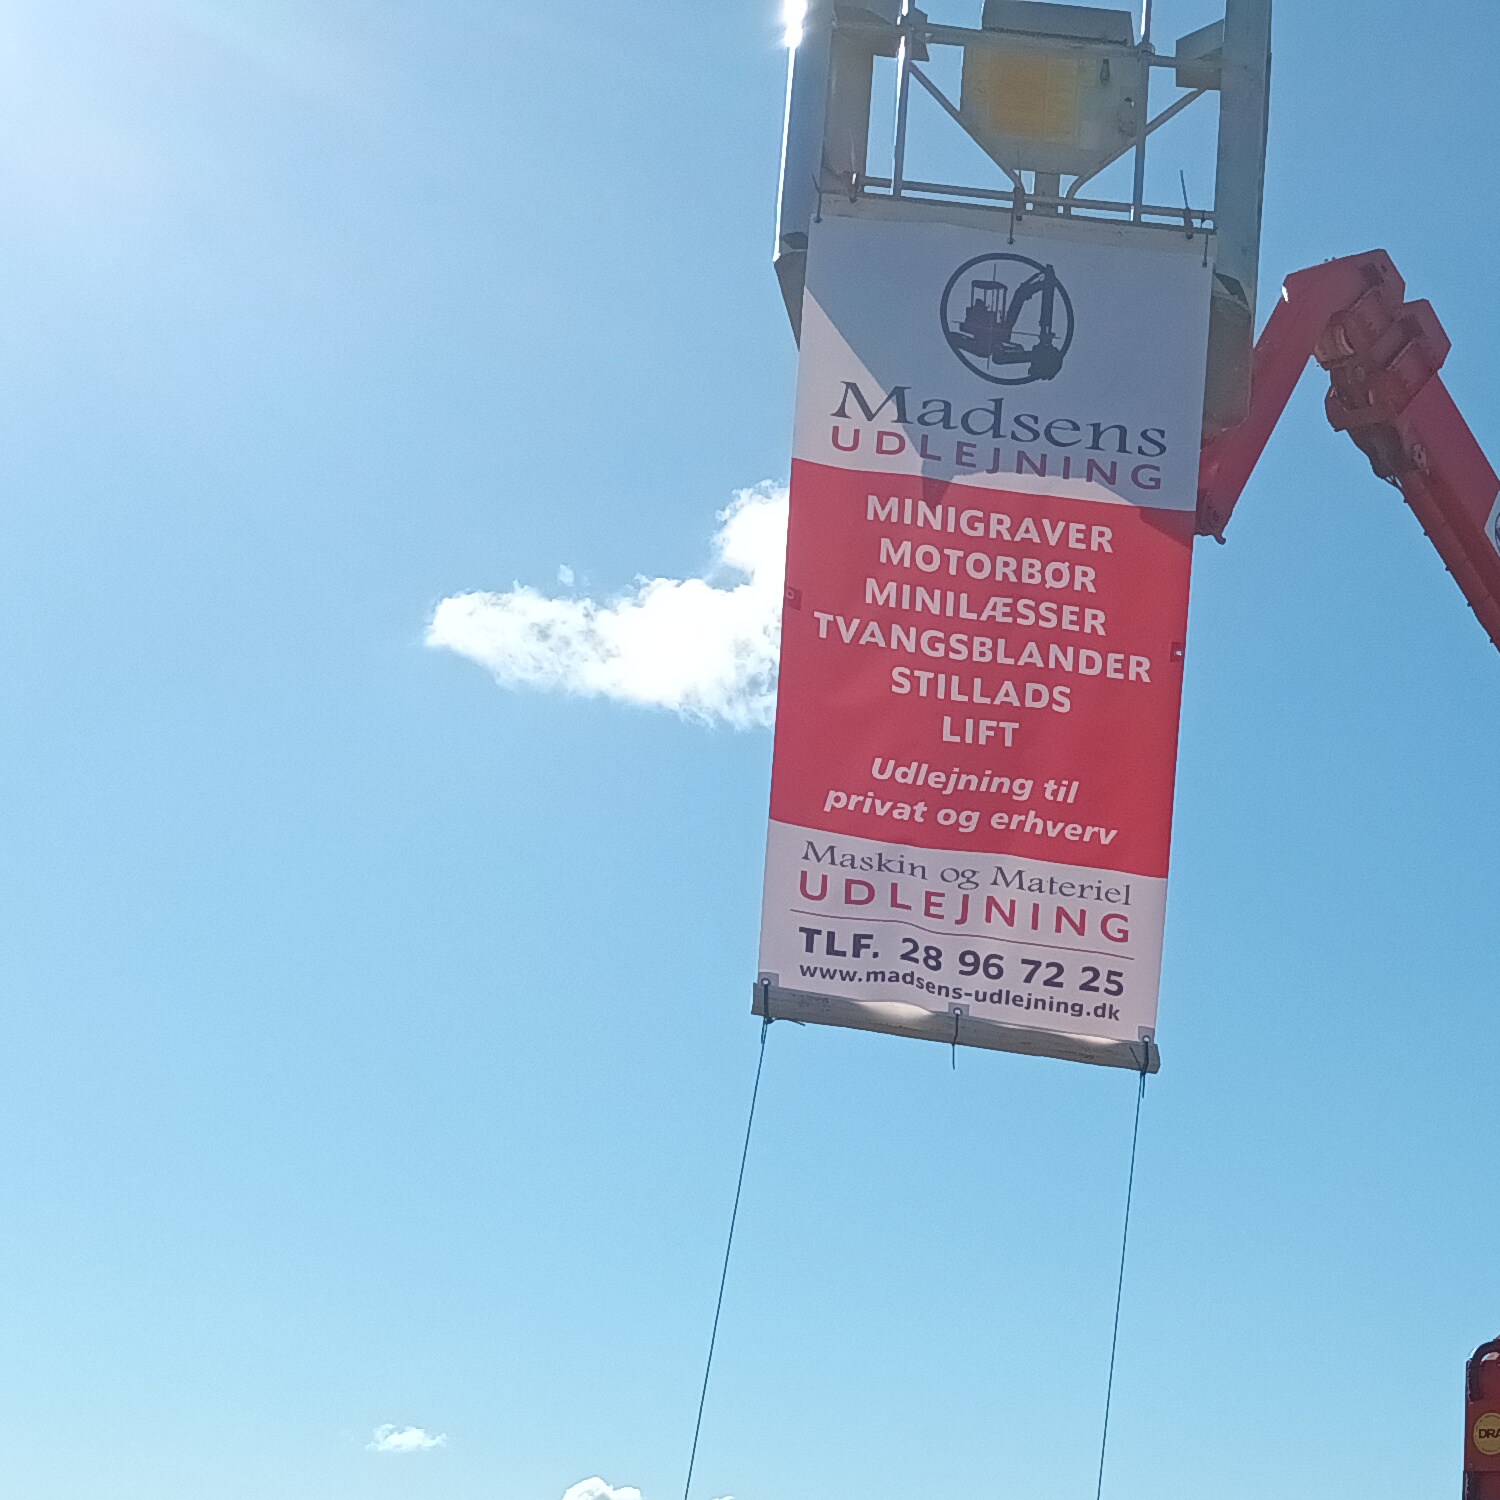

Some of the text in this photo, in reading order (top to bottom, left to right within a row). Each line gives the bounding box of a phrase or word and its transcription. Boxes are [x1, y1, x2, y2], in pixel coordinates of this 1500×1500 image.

[830, 381, 1167, 457] Madsens
[831, 425, 1162, 490] UDLEJNING
[867, 495, 1113, 553] MINIGRAVER
[879, 538, 1096, 593] MOTORBØR
[865, 578, 1106, 636] MINILÆSSER
[814, 611, 1151, 683] TVANGSBLANDER
[891, 667, 1072, 713] STILLADS
[943, 716, 1019, 747] LIFT
[871, 757, 1079, 803] Udlejning til
[823, 790, 1119, 845] privat og erhverv
[801, 840, 1131, 905] Maskin og Materiel
[799, 870, 1130, 943] UDLEJNING
[799, 927, 1124, 996] TLF. 28 96 72 25
[799, 964, 1120, 1021] www.madsens-udlejning.dk
